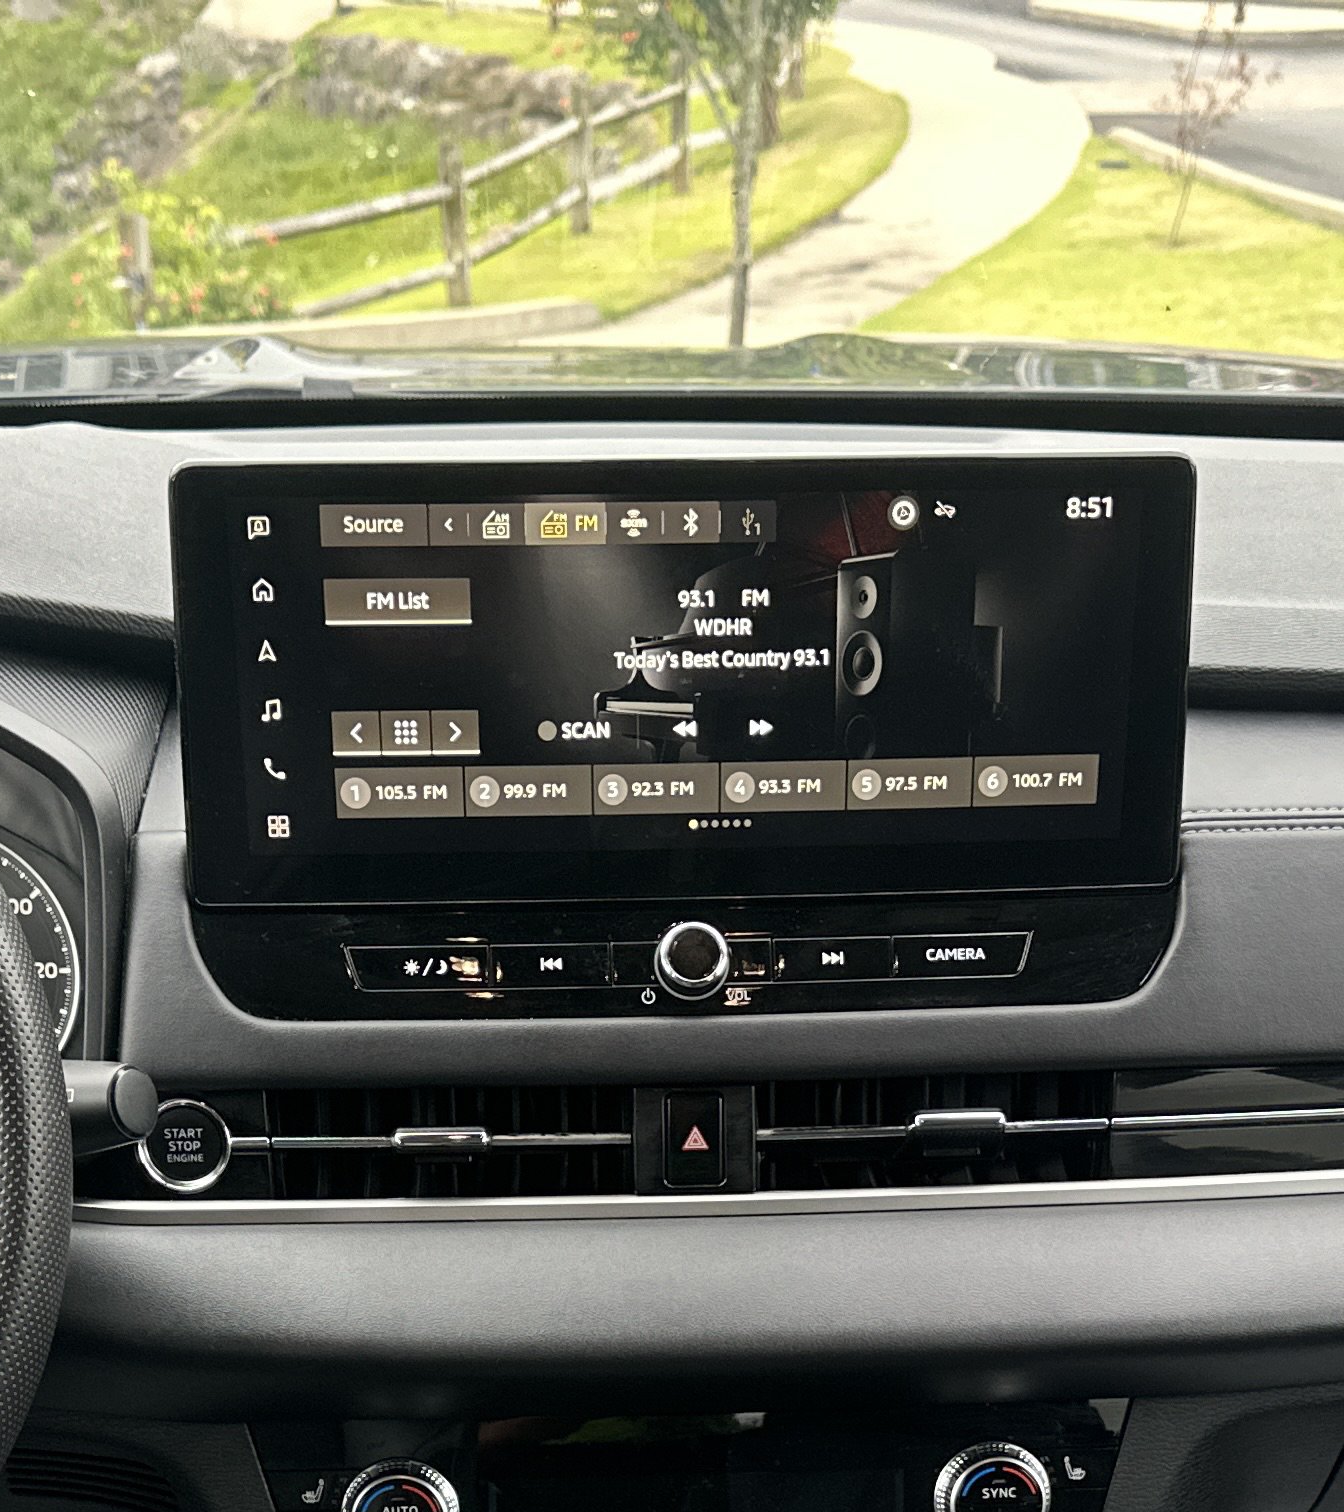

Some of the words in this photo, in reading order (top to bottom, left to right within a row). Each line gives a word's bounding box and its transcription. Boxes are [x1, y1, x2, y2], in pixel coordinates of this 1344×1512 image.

[1065, 496, 1114, 519] 8:51
[343, 515, 404, 534] Source
[575, 514, 599, 532] FM
[753, 523, 761, 535] 1
[366, 592, 394, 610] FM
[398, 591, 430, 610] List
[677, 589, 716, 609] 93.1
[741, 588, 771, 608] FM
[693, 618, 753, 637] WDHR
[613, 651, 679, 673] Today's
[682, 650, 720, 669] Best
[721, 649, 791, 671] Country
[793, 648, 831, 668] 93.1
[561, 721, 612, 740] SCAN
[606, 782, 619, 799] 3
[631, 782, 664, 798] 92.3
[669, 781, 695, 797] FM
[733, 780, 747, 796] 4
[758, 779, 791, 795] 93.3
[797, 778, 822, 794] FM
[860, 777, 873, 793] 5
[885, 776, 918, 792] 97.5
[923, 775, 948, 791] FM
[986, 774, 999, 790] 6
[1012, 773, 1053, 788] 100.7
[1058, 772, 1083, 788] FM
[349, 784, 360, 802] 1
[375, 785, 417, 801] 105.5
[423, 785, 448, 801] FM
[479, 783, 492, 800] 2
[503, 784, 537, 800] 99.9
[542, 783, 567, 799] FM
[924, 946, 986, 964] CAMERA
[726, 988, 752, 1002] VOL
[164, 1127, 204, 1139] START
[169, 1139, 202, 1152] STOP
[167, 1152, 205, 1164] ENGINE
[981, 1486, 1017, 1500] SYNC
